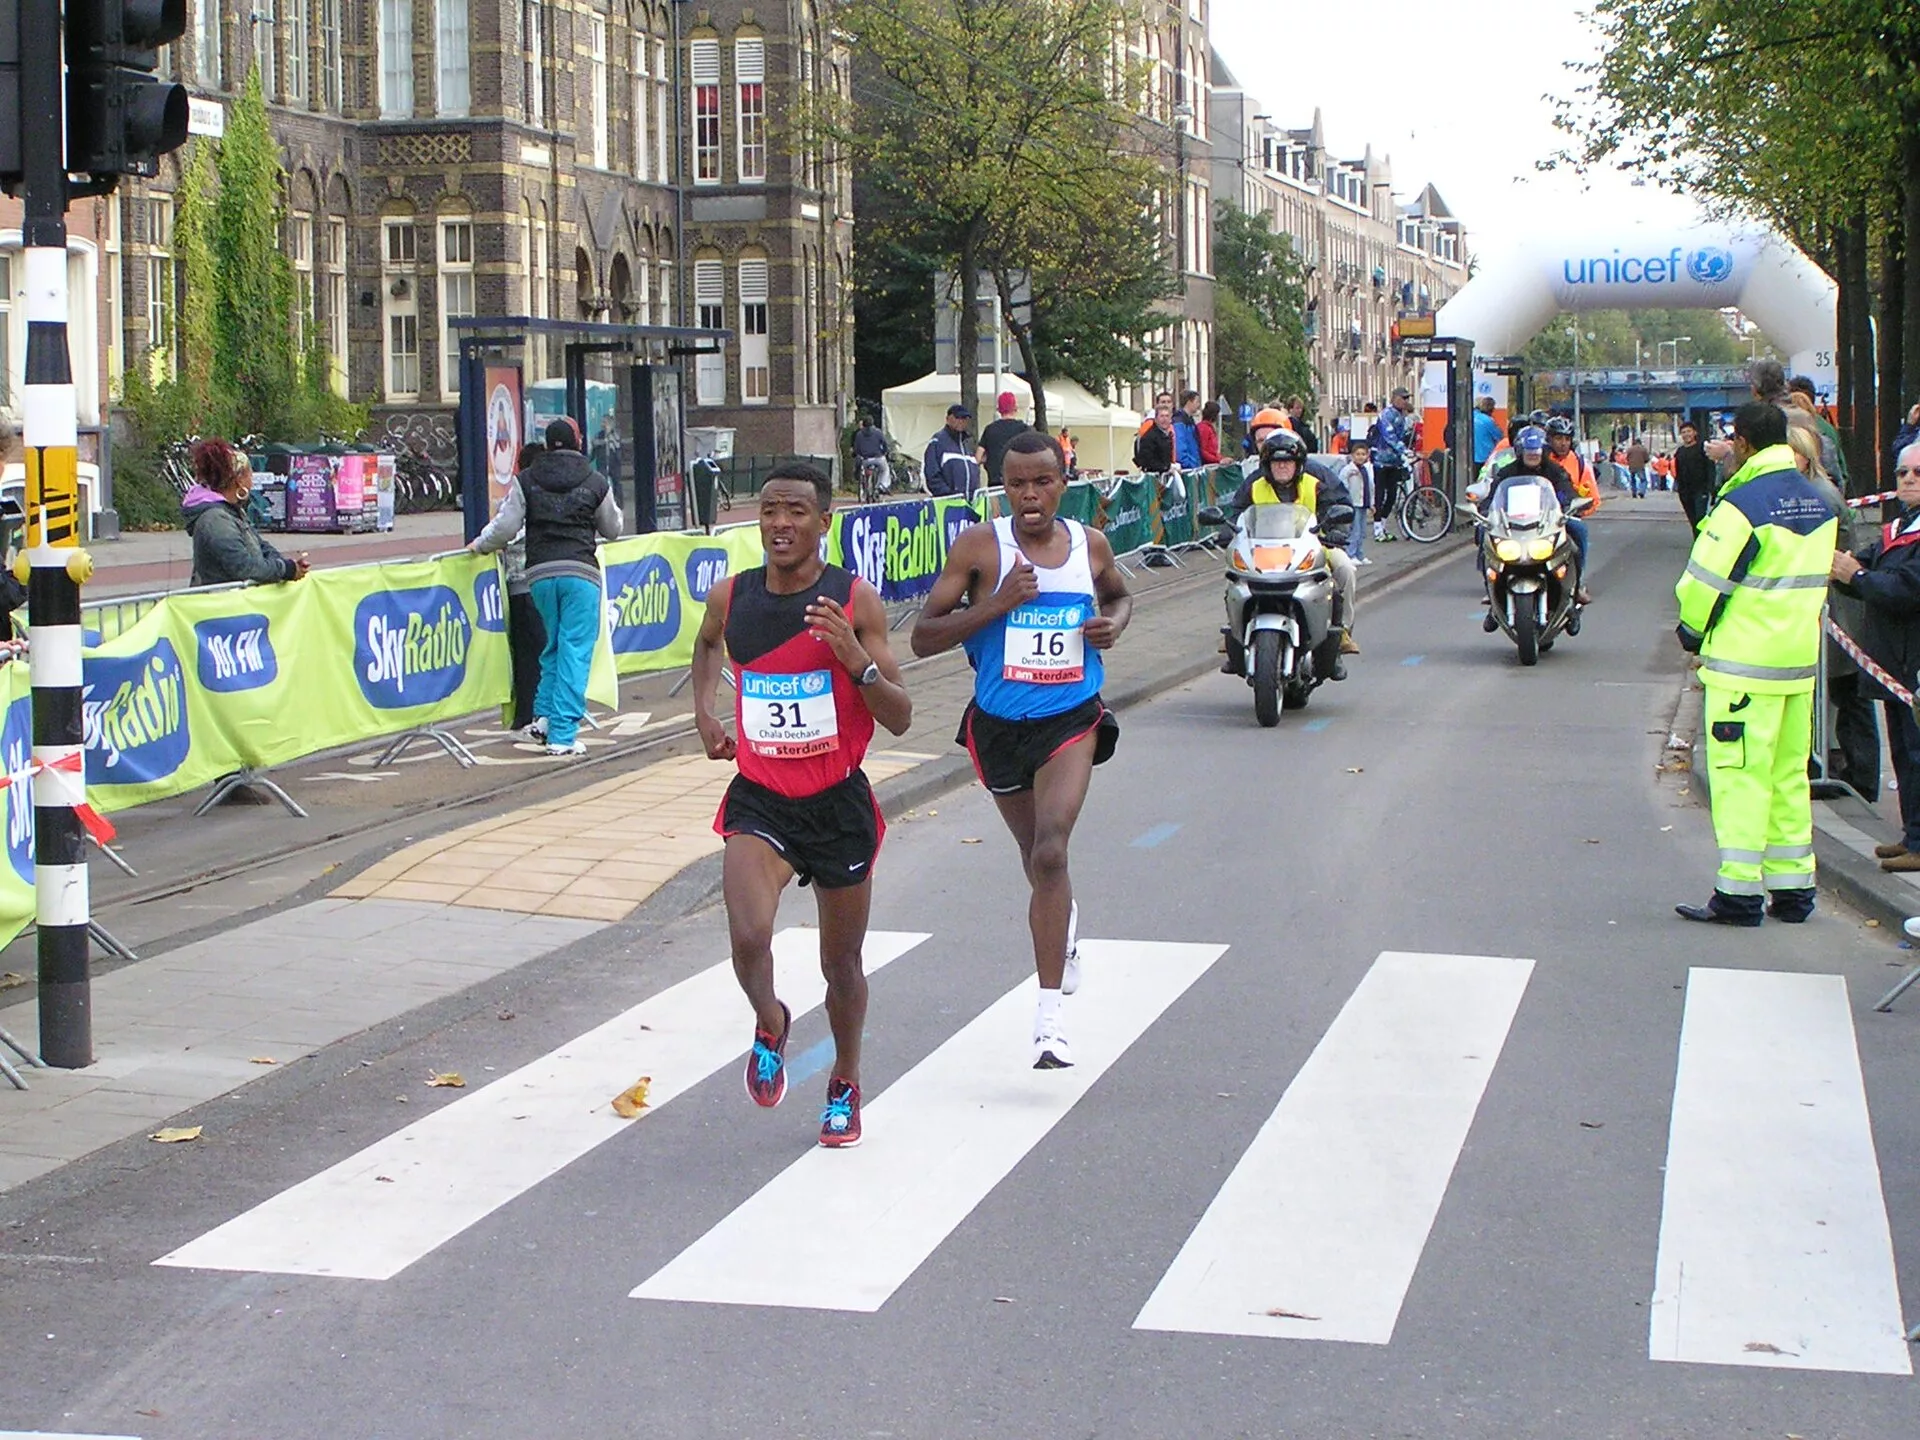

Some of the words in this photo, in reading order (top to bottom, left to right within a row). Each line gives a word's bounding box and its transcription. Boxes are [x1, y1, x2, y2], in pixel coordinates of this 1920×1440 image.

[1564, 248, 1682, 284] unicef
[1815, 351, 1830, 367] 35
[852, 506, 938, 595] SkyRadio
[1010, 609, 1066, 626] unicef
[207, 633, 232, 680] 101
[235, 628, 264, 674] FM
[367, 602, 464, 693] SkyRadio
[1031, 632, 1065, 656] 16
[1021, 657, 1048, 666] Deriba
[745, 676, 800, 696] unicef
[767, 702, 807, 728] 31
[759, 729, 783, 739] Chala
[784, 728, 820, 740] Dechase
